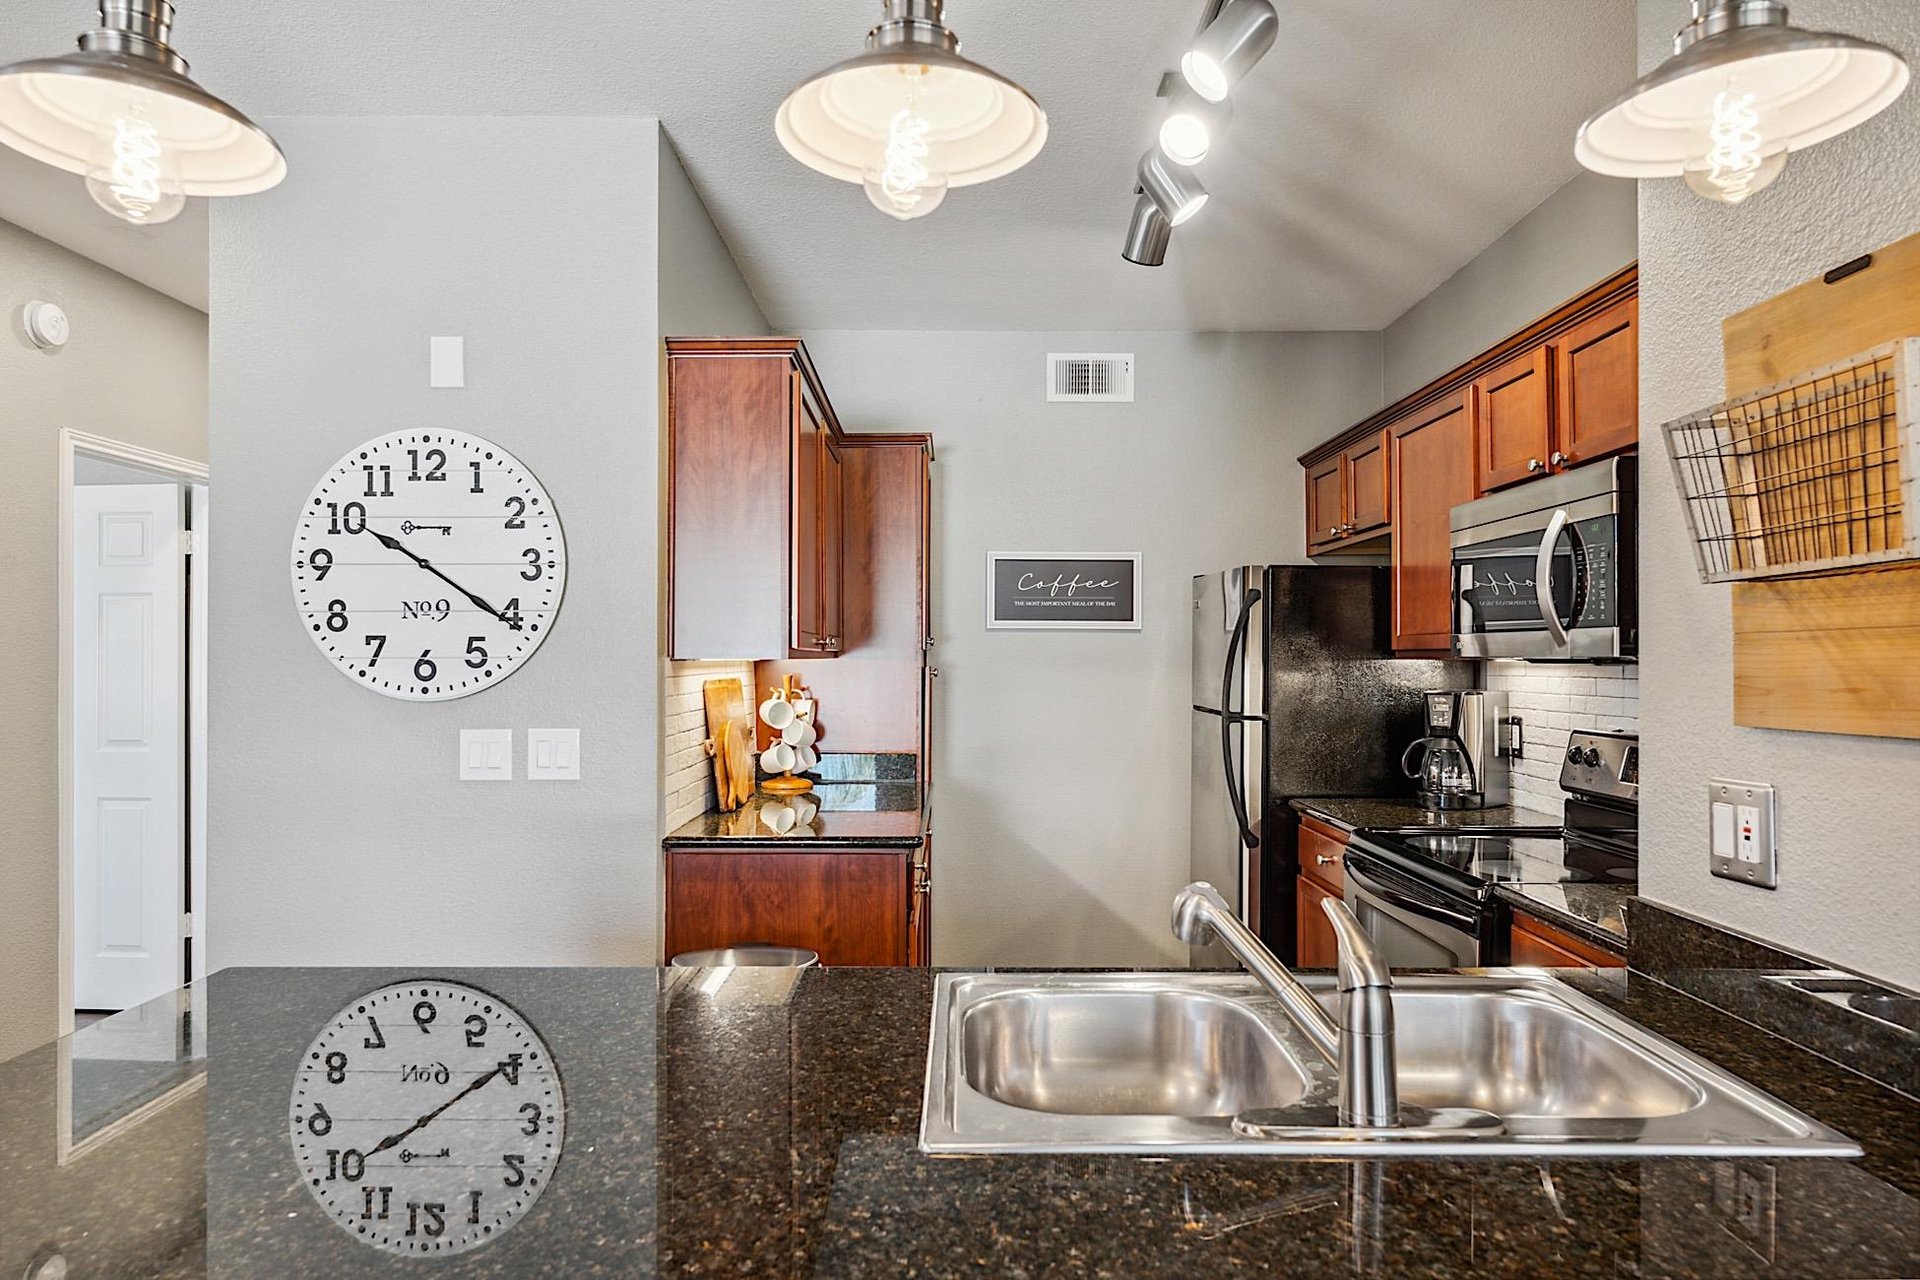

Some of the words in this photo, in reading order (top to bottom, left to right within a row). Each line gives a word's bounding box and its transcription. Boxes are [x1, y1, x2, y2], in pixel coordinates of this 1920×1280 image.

[363, 465, 394, 497] 11
[407, 449, 447, 481] 12
[469, 462, 484, 493] 1
[327, 502, 366, 534] 10
[504, 496, 526, 529] 2
[310, 548, 333, 581] 9
[520, 548, 542, 581] 3
[1018, 573, 1119, 597] Coffee
[326, 599, 348, 632] 8
[498, 598, 524, 631] 4
[365, 635, 387, 667] 7
[413, 650, 437, 682] 6
[464, 637, 488, 669] 5
